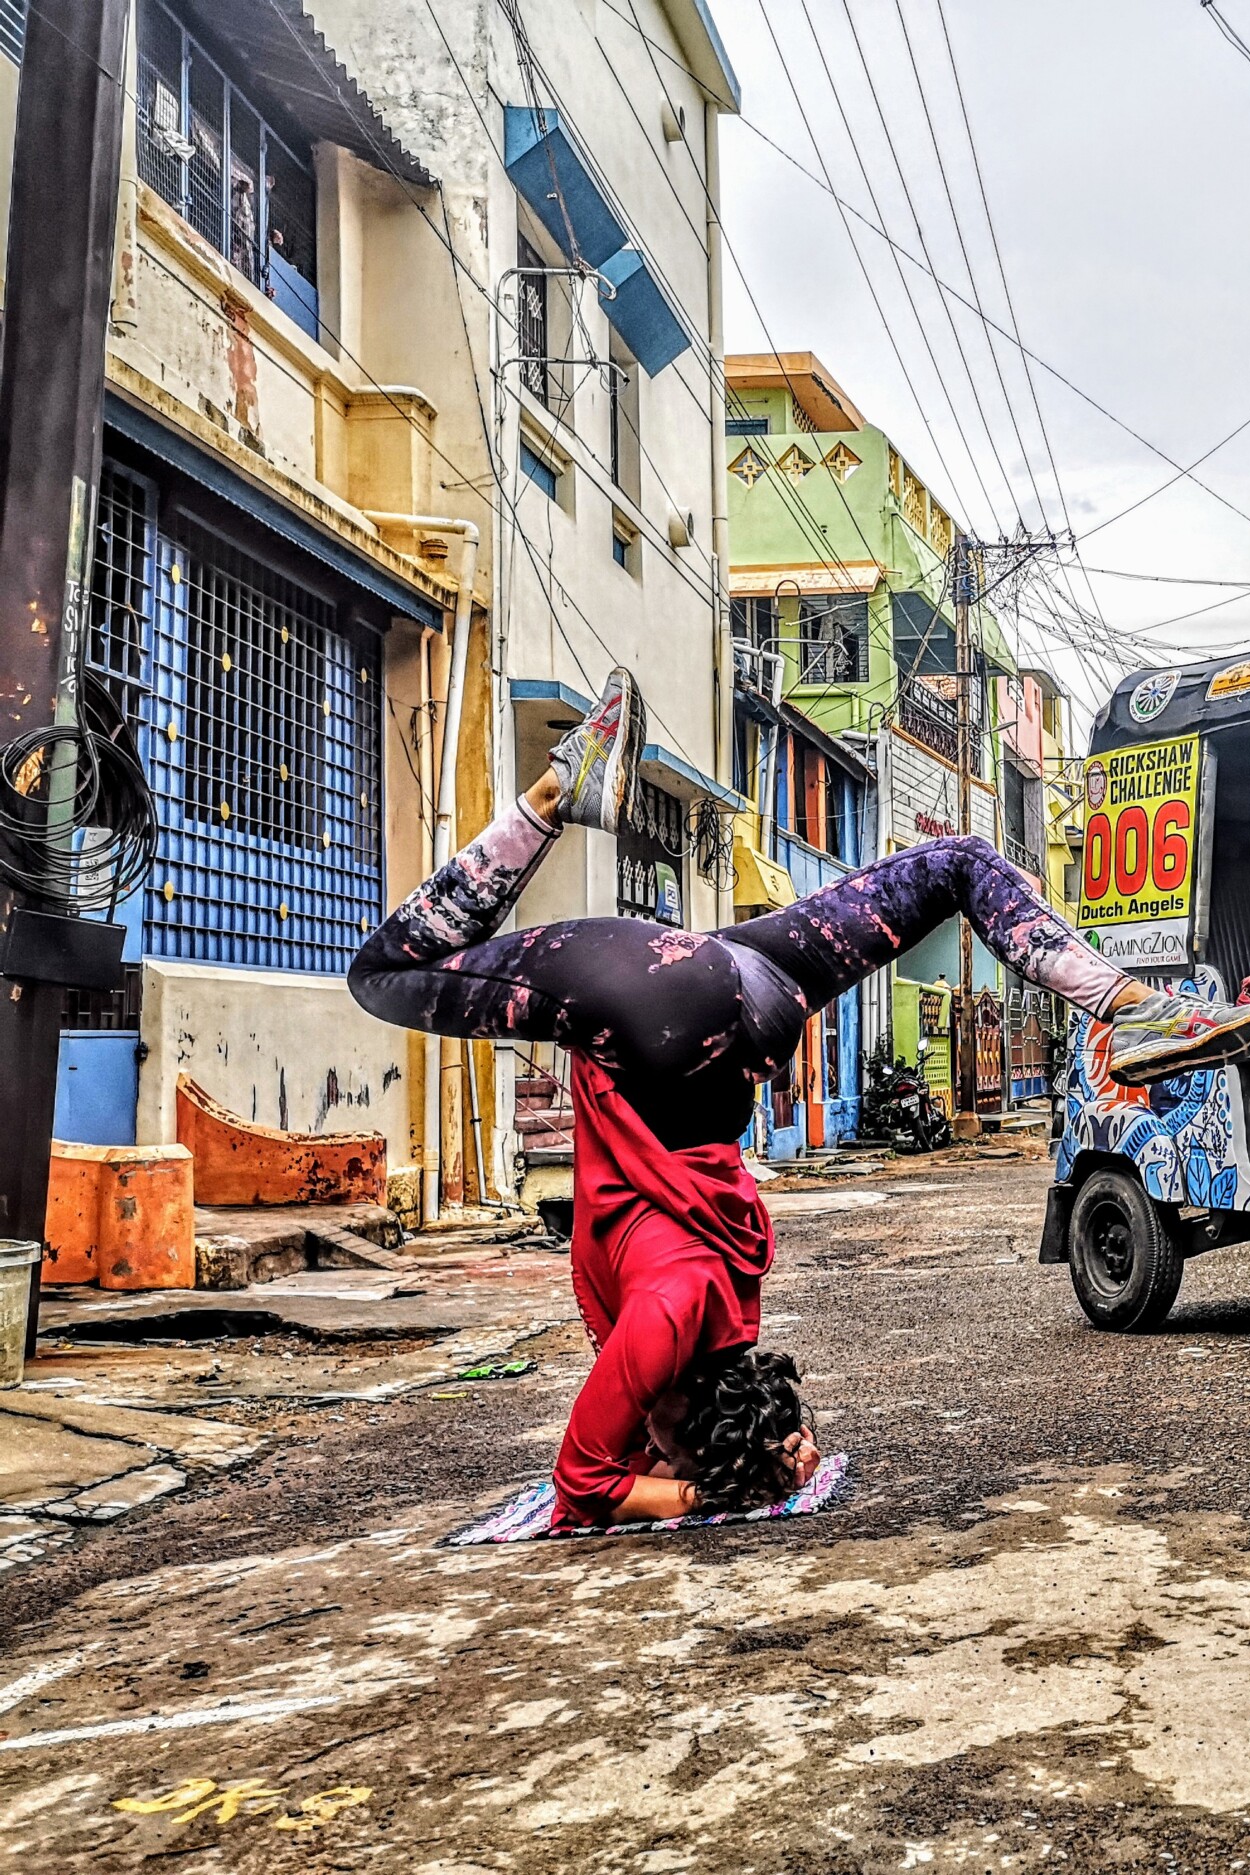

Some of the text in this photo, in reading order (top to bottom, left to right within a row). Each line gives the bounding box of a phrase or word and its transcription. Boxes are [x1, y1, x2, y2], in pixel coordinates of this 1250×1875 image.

[1108, 741, 1194, 779] RICKSHAW
[1110, 766, 1192, 805] CHALLENGE
[1084, 799, 1190, 900] 006
[1081, 894, 1185, 920] Dutch Angels
[1101, 931, 1186, 958] GAMINGZION
[1165, 954, 1181, 962] GAME
